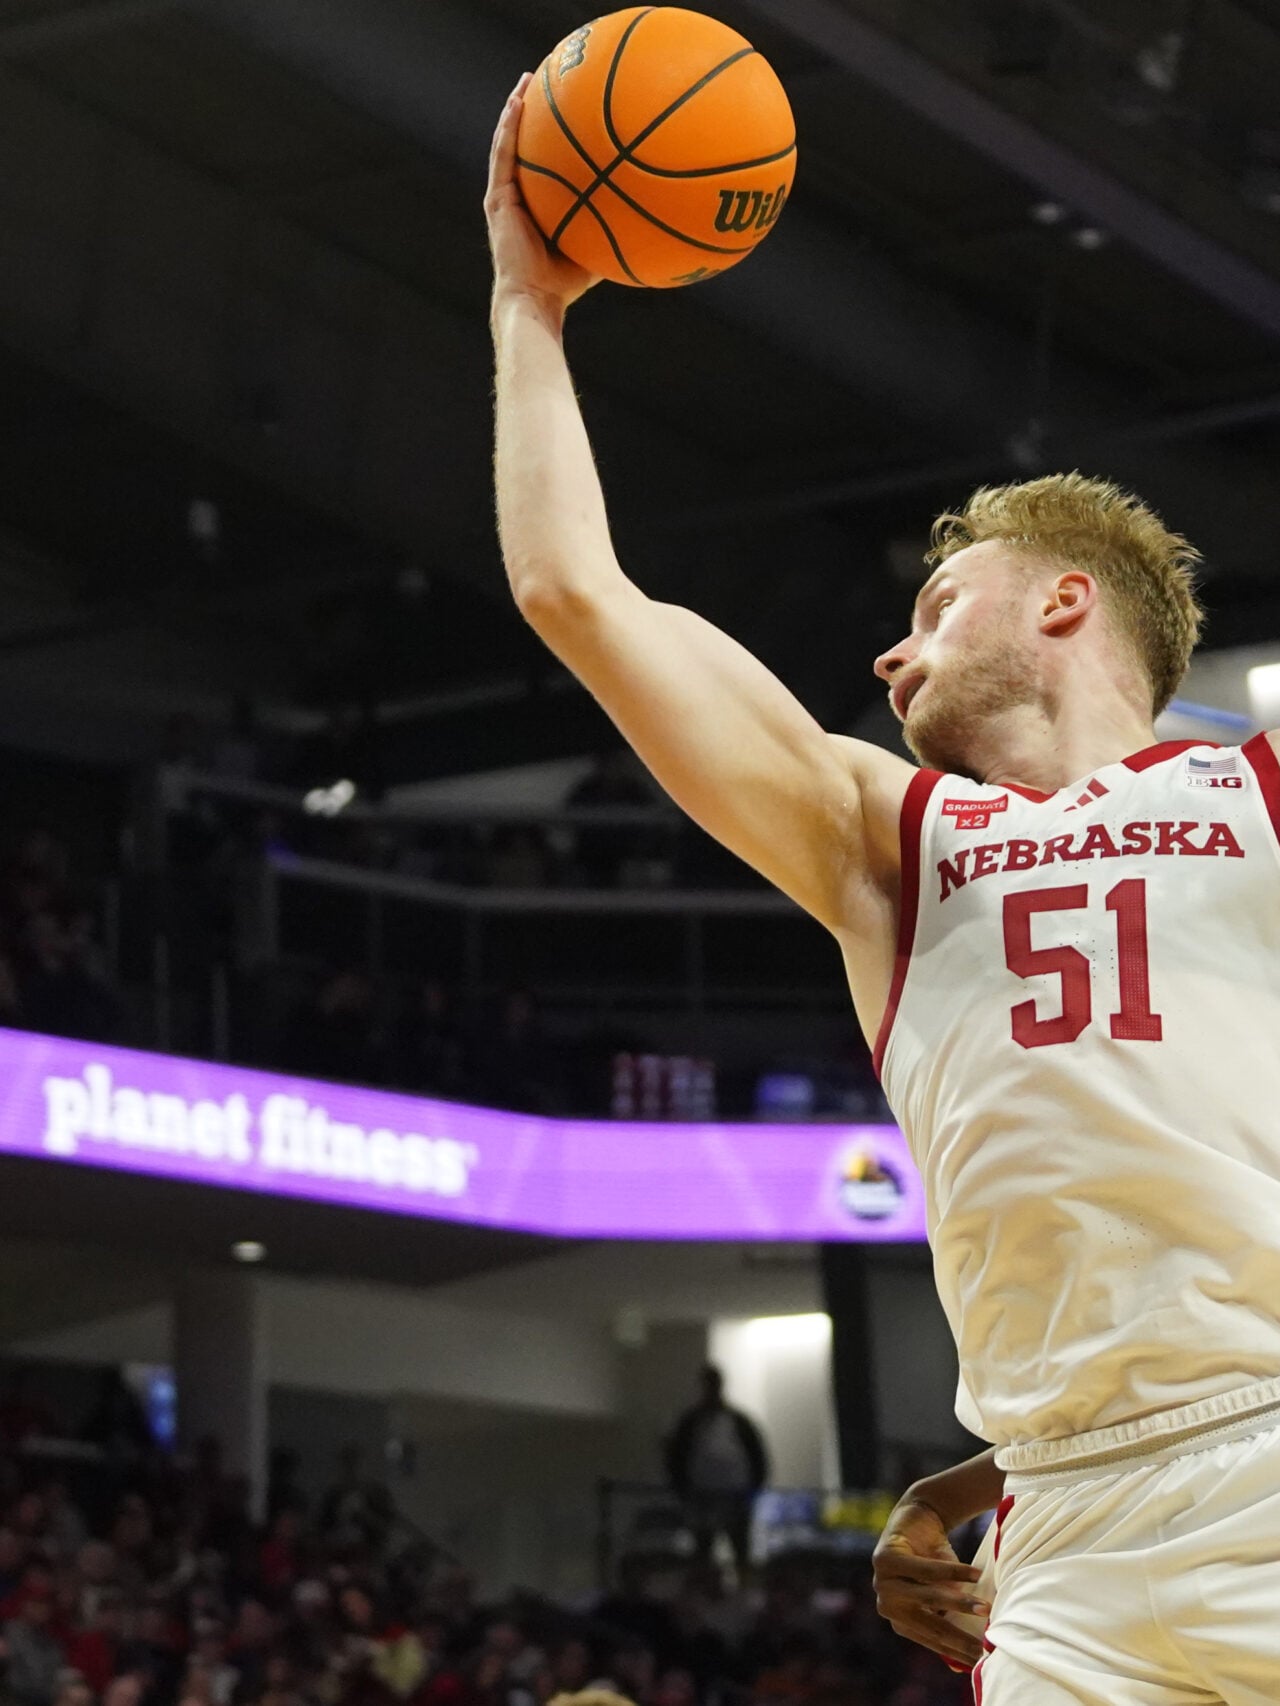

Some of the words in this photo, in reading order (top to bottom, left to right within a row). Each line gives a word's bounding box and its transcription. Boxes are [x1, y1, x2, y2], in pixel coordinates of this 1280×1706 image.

[945, 800, 1006, 811] GRADUATE
[937, 821, 1245, 903] NEBRASKA
[1003, 878, 1162, 1049] 51
[43, 1063, 252, 1160] planet
[259, 1094, 469, 1196] fitness
